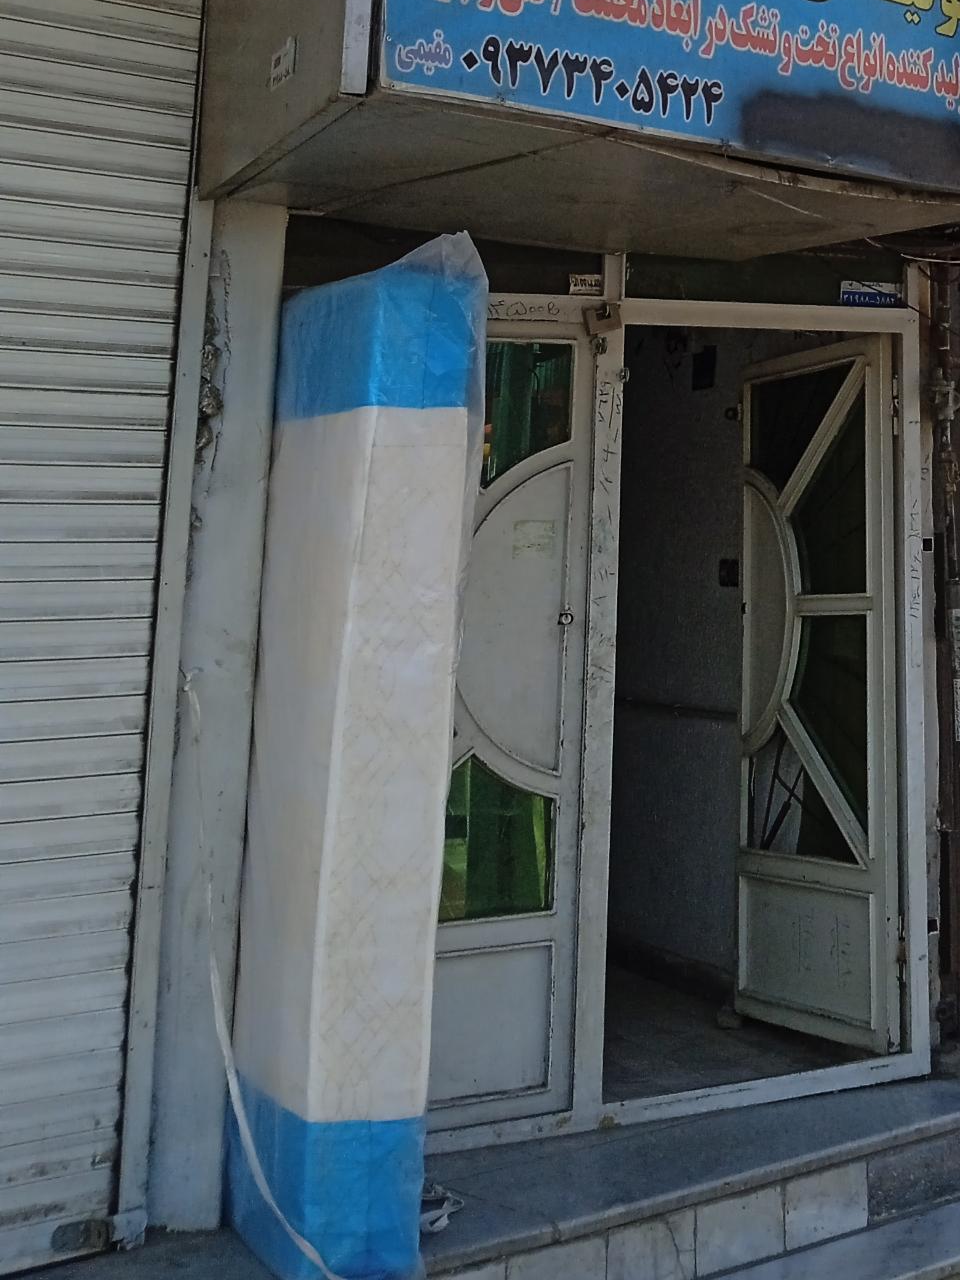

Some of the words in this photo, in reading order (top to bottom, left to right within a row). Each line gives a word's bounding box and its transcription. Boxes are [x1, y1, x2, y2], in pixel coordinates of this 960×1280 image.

[700, 5, 728, 58] در
[729, 2, 780, 57] تشک
[778, 31, 793, 76] و
[794, 19, 838, 69] تخت
[462, 34, 724, 126] ۰۹۳۷۳۴۰۵۴۲۴
[838, 28, 886, 93] انواع
[887, 49, 934, 91] کننده
